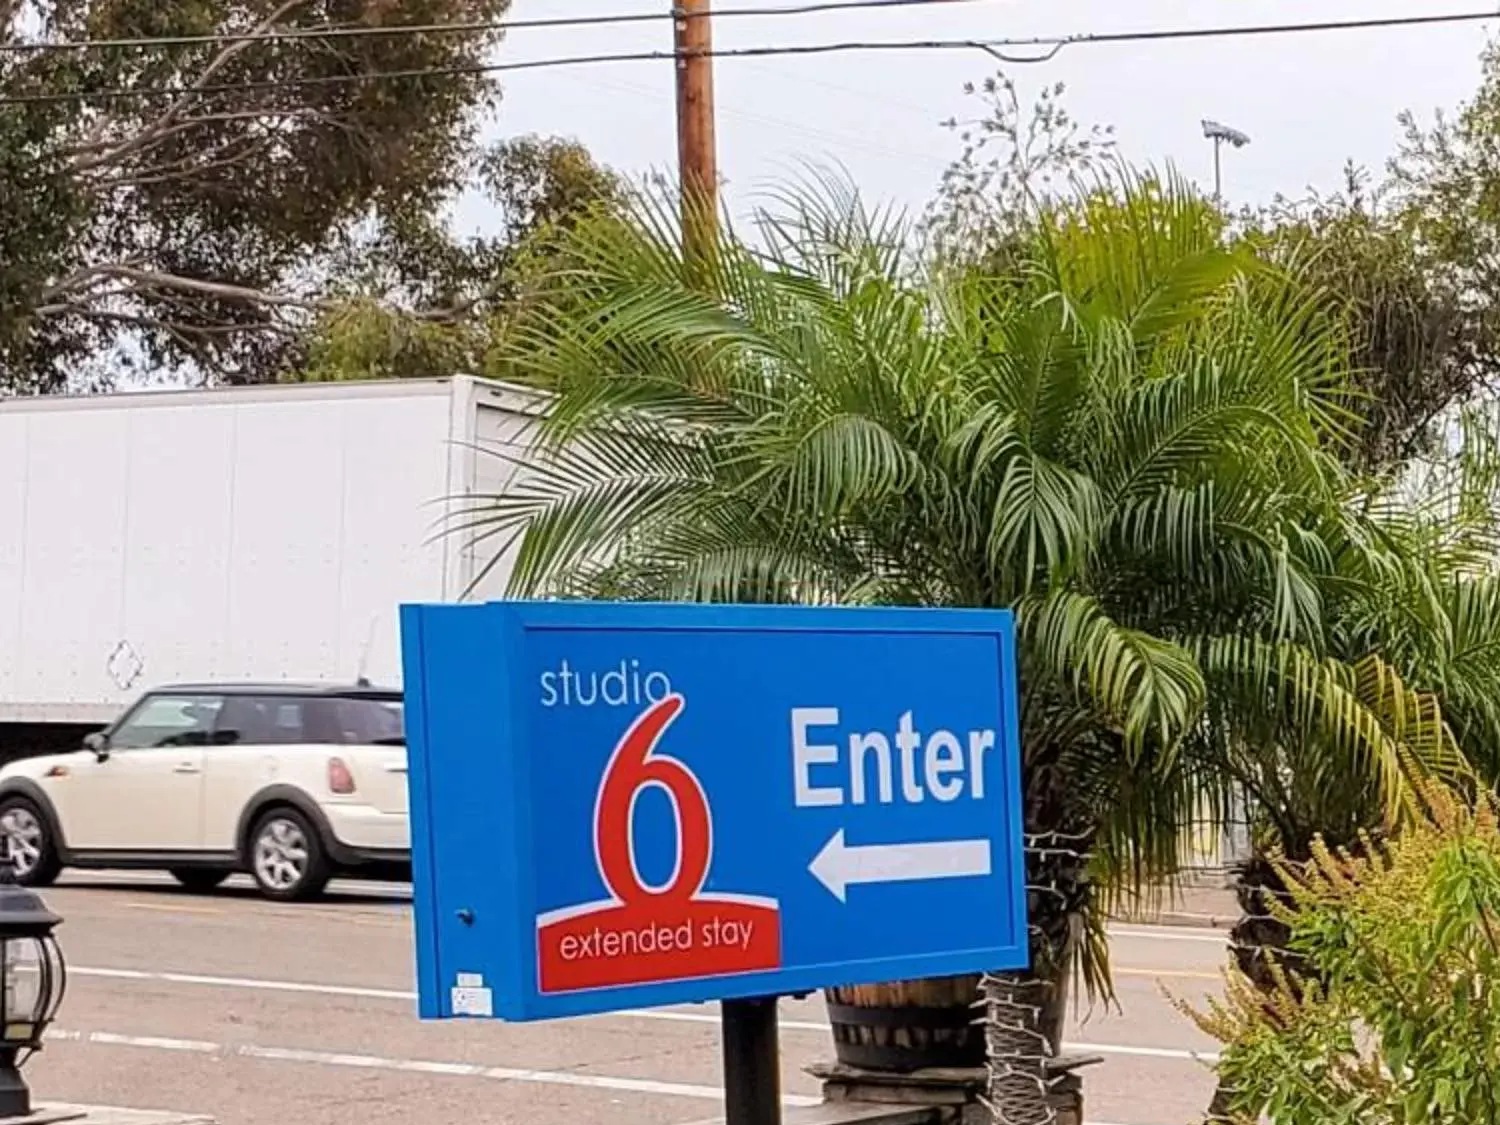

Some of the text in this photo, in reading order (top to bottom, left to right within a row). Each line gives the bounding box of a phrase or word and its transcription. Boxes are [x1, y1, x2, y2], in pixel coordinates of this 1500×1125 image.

[540, 658, 672, 706] studio
[790, 707, 996, 808] Enter
[593, 692, 714, 906] 6
[559, 914, 754, 960] extended stay
